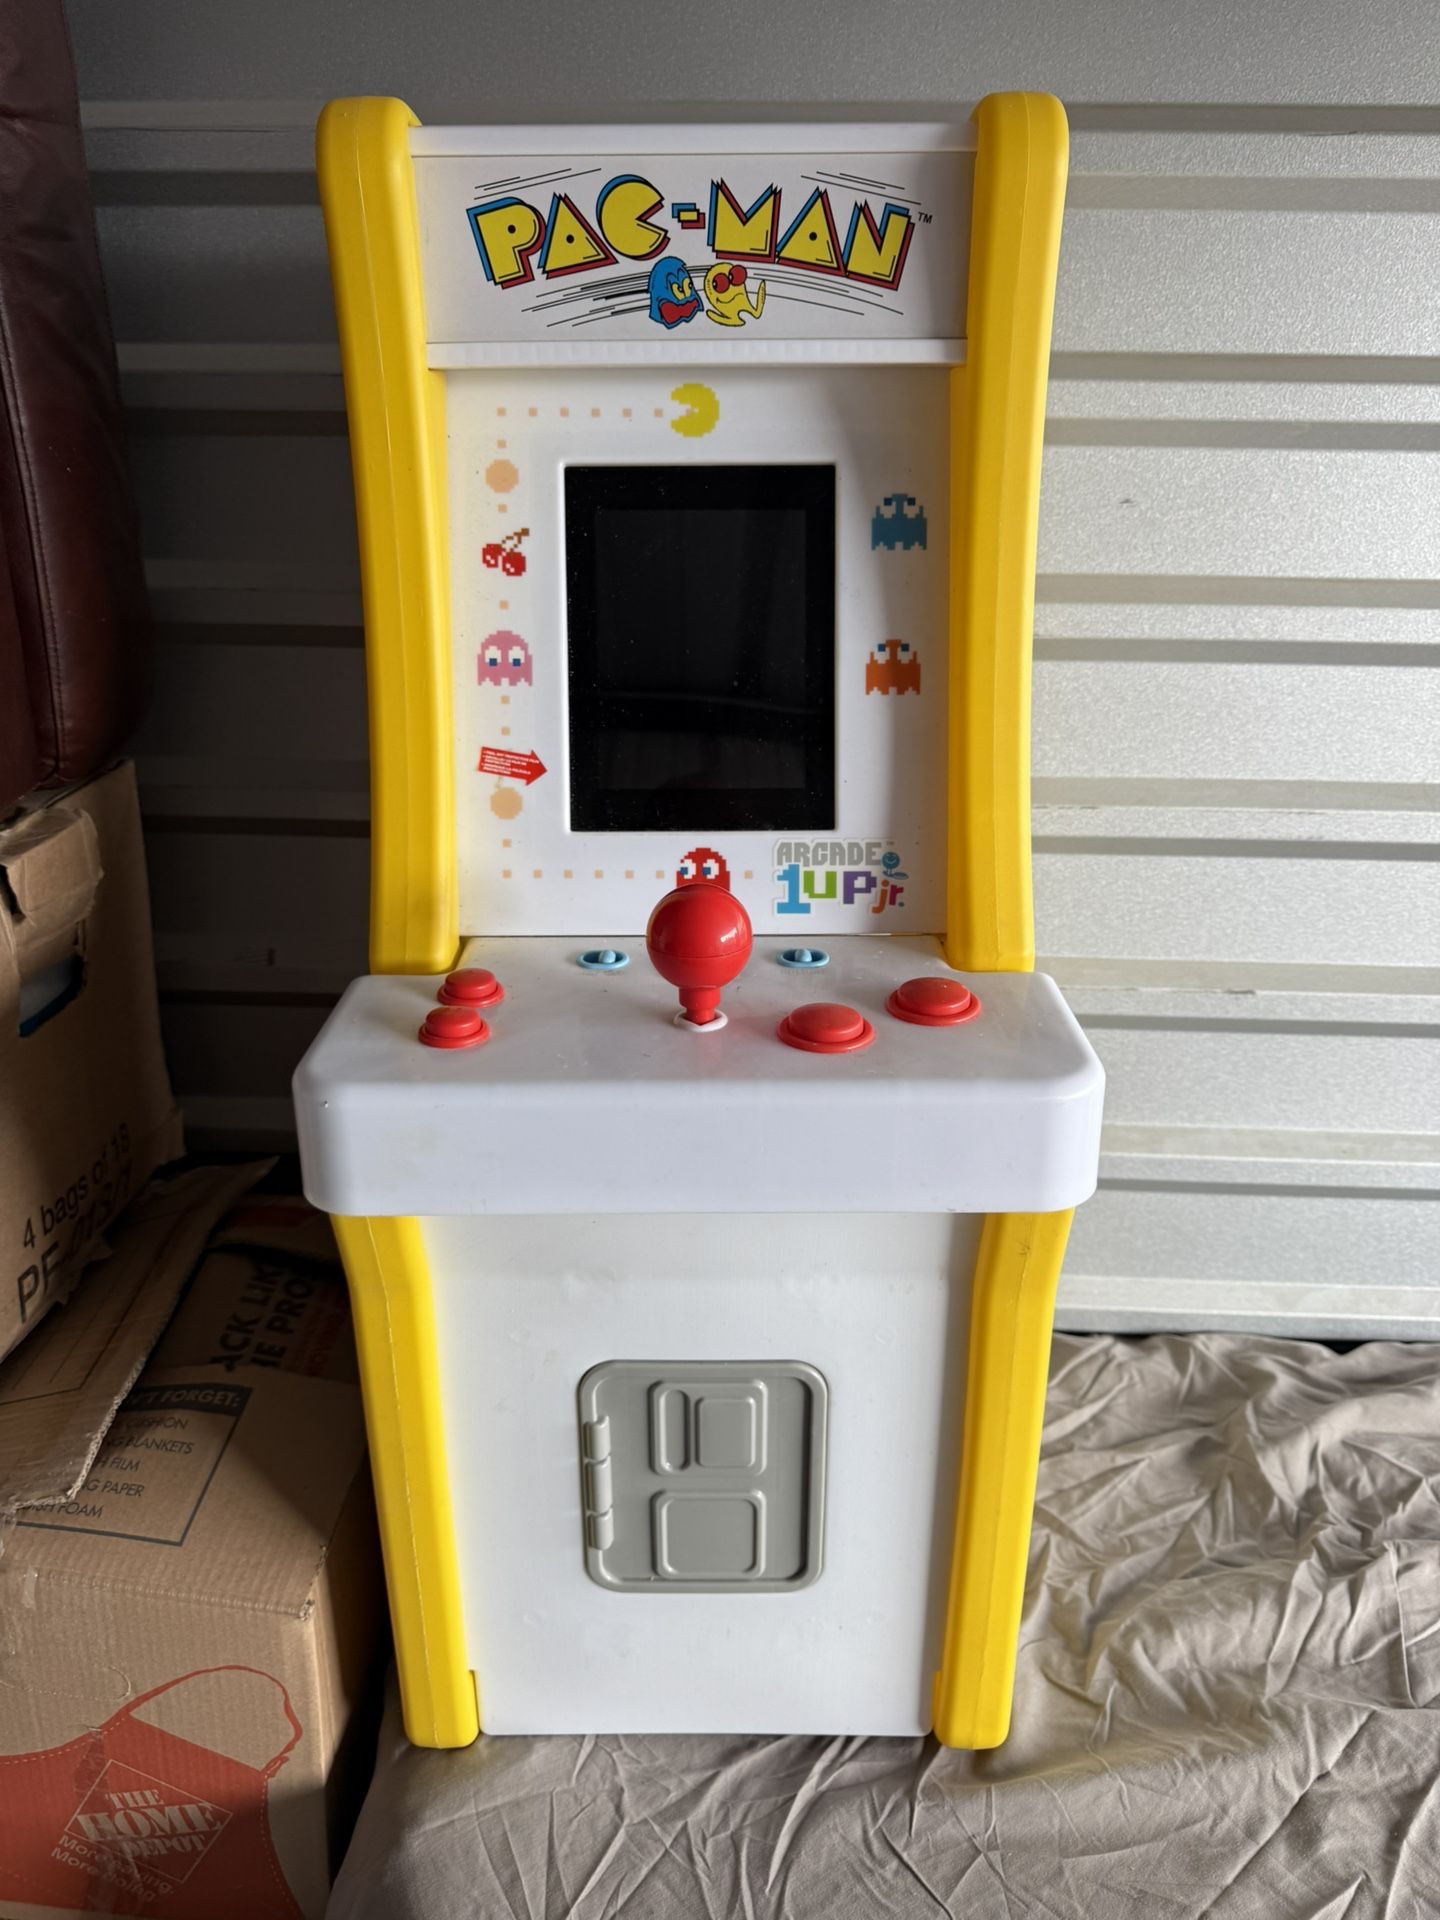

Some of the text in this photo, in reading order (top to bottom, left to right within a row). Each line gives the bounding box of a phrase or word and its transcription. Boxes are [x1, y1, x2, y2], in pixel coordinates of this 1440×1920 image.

[465, 173, 915, 291] PAC-MAN
[777, 842, 882, 867] ARCADE
[24, 1217, 36, 1249] 4
[40, 1175, 88, 1236] bags
[267, 1278, 312, 1334] PRO
[209, 1312, 261, 1373] ACK
[160, 1388, 242, 1408] FORGET:
[125, 1435, 194, 1454] BLANKETS
[110, 1456, 141, 1472] FILM
[103, 1482, 145, 1498] PAPER
[105, 1789, 164, 1809] THE
[76, 1802, 224, 1841] HOME
